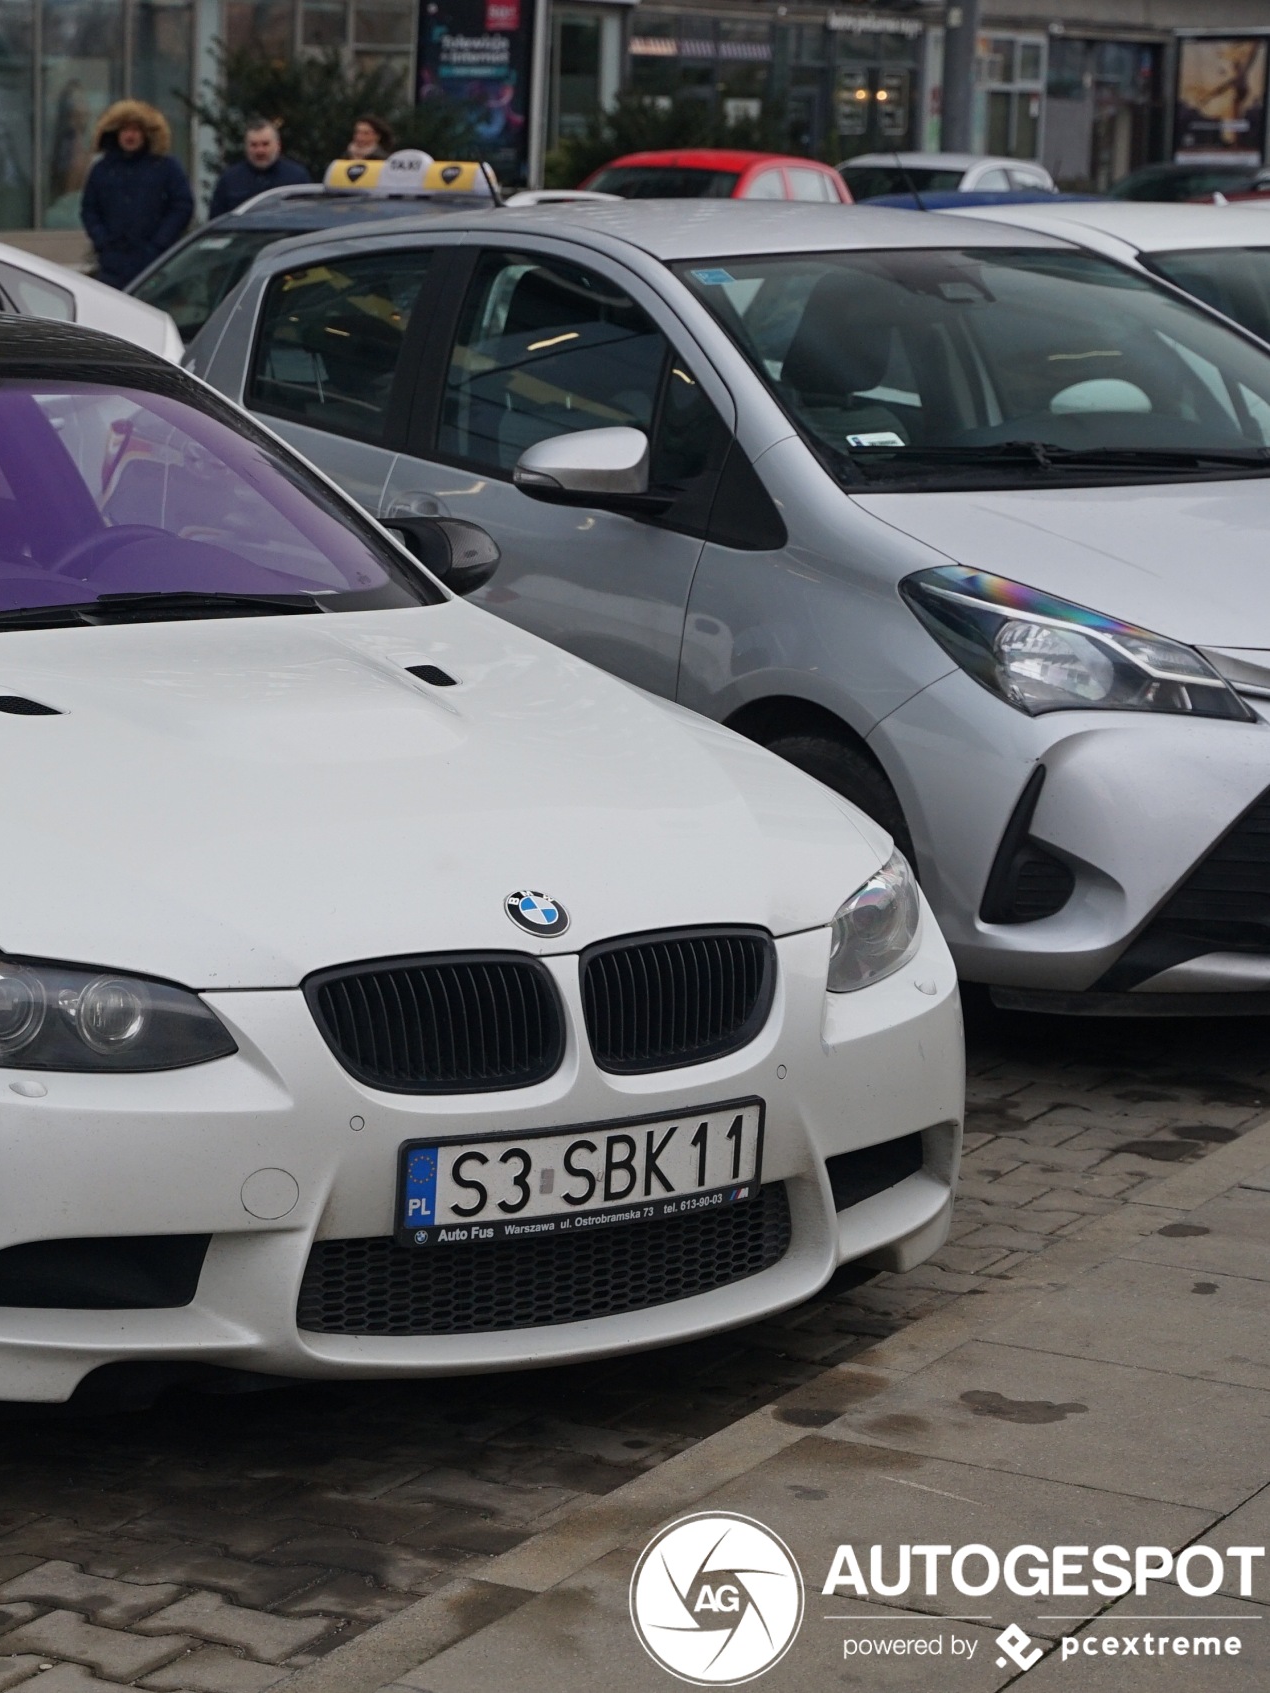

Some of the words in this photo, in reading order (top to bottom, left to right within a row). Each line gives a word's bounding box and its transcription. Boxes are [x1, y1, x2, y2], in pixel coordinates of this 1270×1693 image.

[390, 158, 423, 171] TAXI
[508, 890, 555, 906] BMW
[450, 1147, 531, 1218] S3
[561, 1114, 744, 1206] SBK11
[408, 1198, 431, 1216] PL
[437, 1228, 468, 1242] Auto
[471, 1226, 494, 1240] Fus
[504, 1221, 555, 1235] Warszawa
[560, 1218, 572, 1229] ul.
[574, 1209, 641, 1227] Ostrobramska
[643, 1206, 655, 1218] 73
[663, 1202, 678, 1214] tel.
[680, 1193, 723, 1211] 613-90-03
